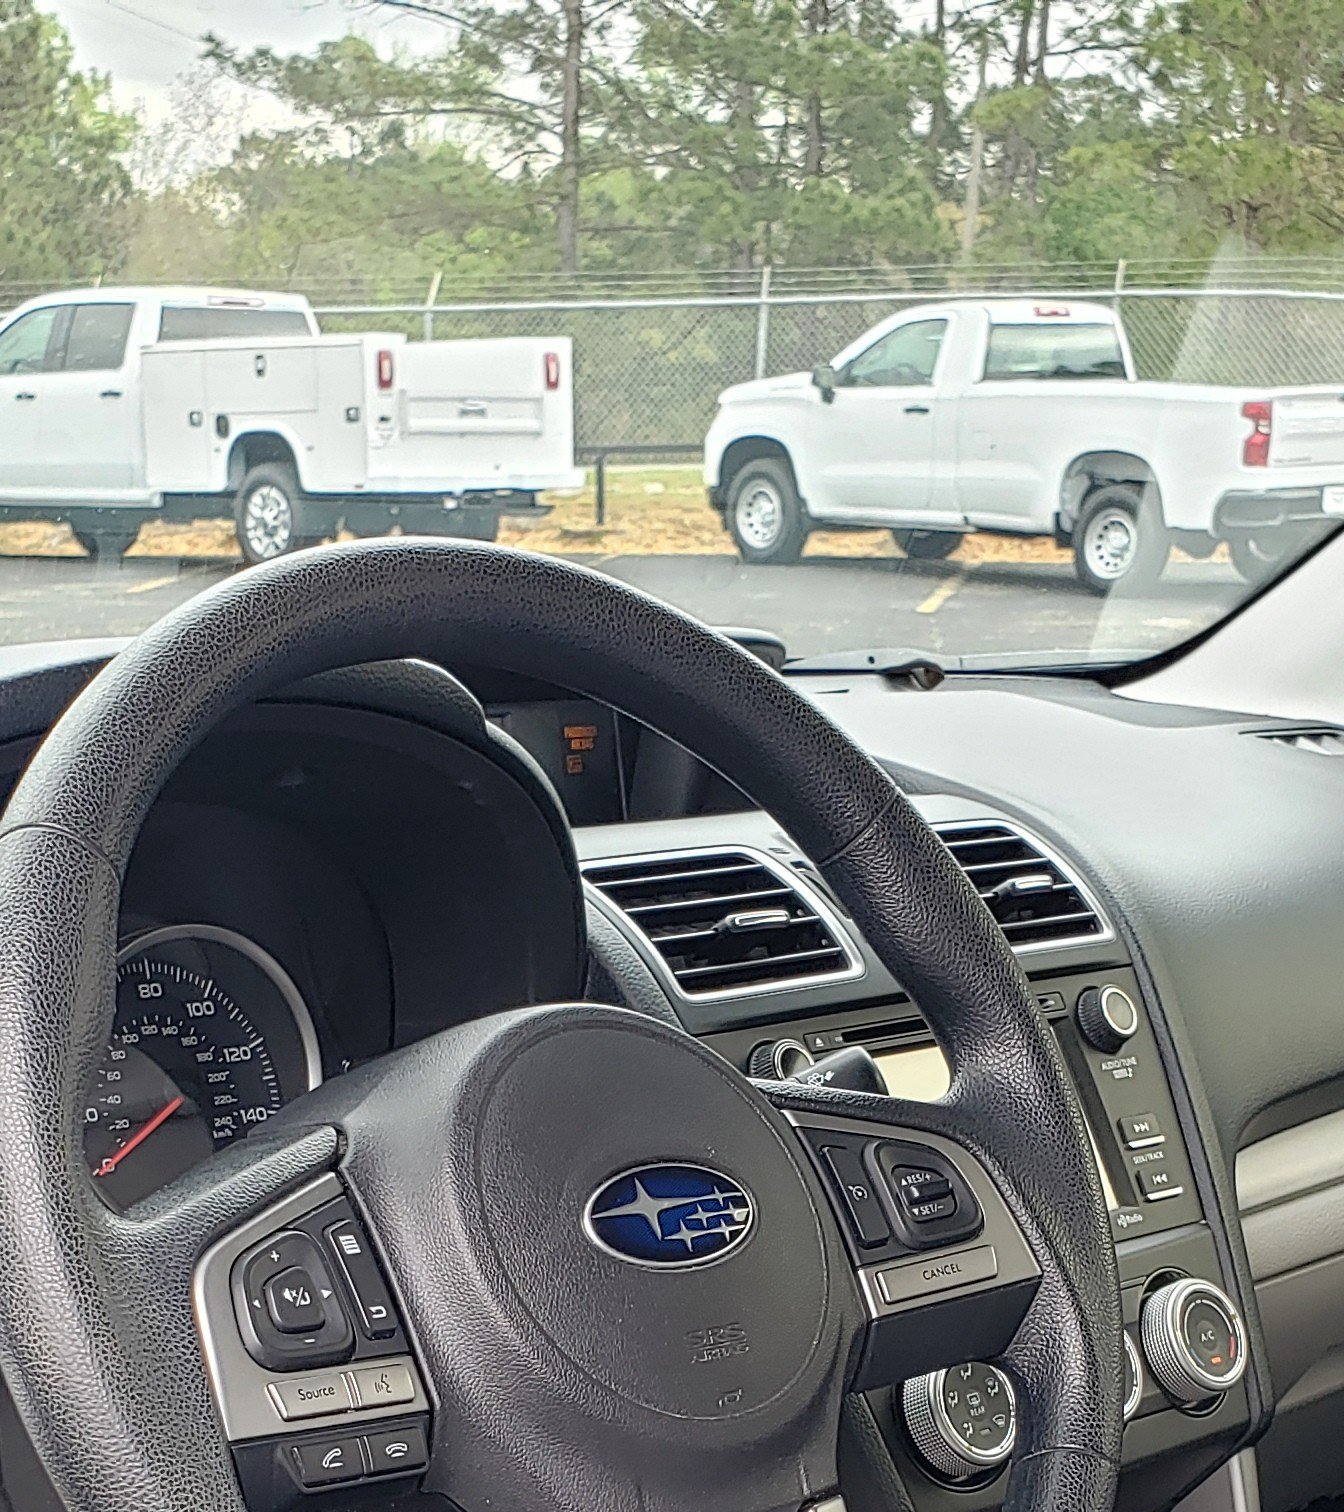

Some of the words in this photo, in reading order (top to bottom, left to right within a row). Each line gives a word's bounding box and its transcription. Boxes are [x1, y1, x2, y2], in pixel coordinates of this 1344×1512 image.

[138, 983, 162, 998] 80
[186, 1001, 215, 1017] 100
[141, 1024, 158, 1035] 120
[161, 1025, 178, 1036] 140
[122, 1033, 139, 1044] 100
[181, 1036, 198, 1047] 160
[111, 1050, 126, 1060] 80
[223, 1046, 251, 1063] 120
[107, 1070, 121, 1081] 60
[208, 1072, 226, 1083] 200
[107, 1094, 121, 1104] 40
[214, 1095, 232, 1106] 220
[240, 1107, 267, 1124] 140
[115, 1119, 130, 1129] 20
[214, 1116, 232, 1127] 240
[922, 1263, 963, 1281] CANCEL
[1201, 1330, 1215, 1342] A/C
[297, 1386, 336, 1401] Source
